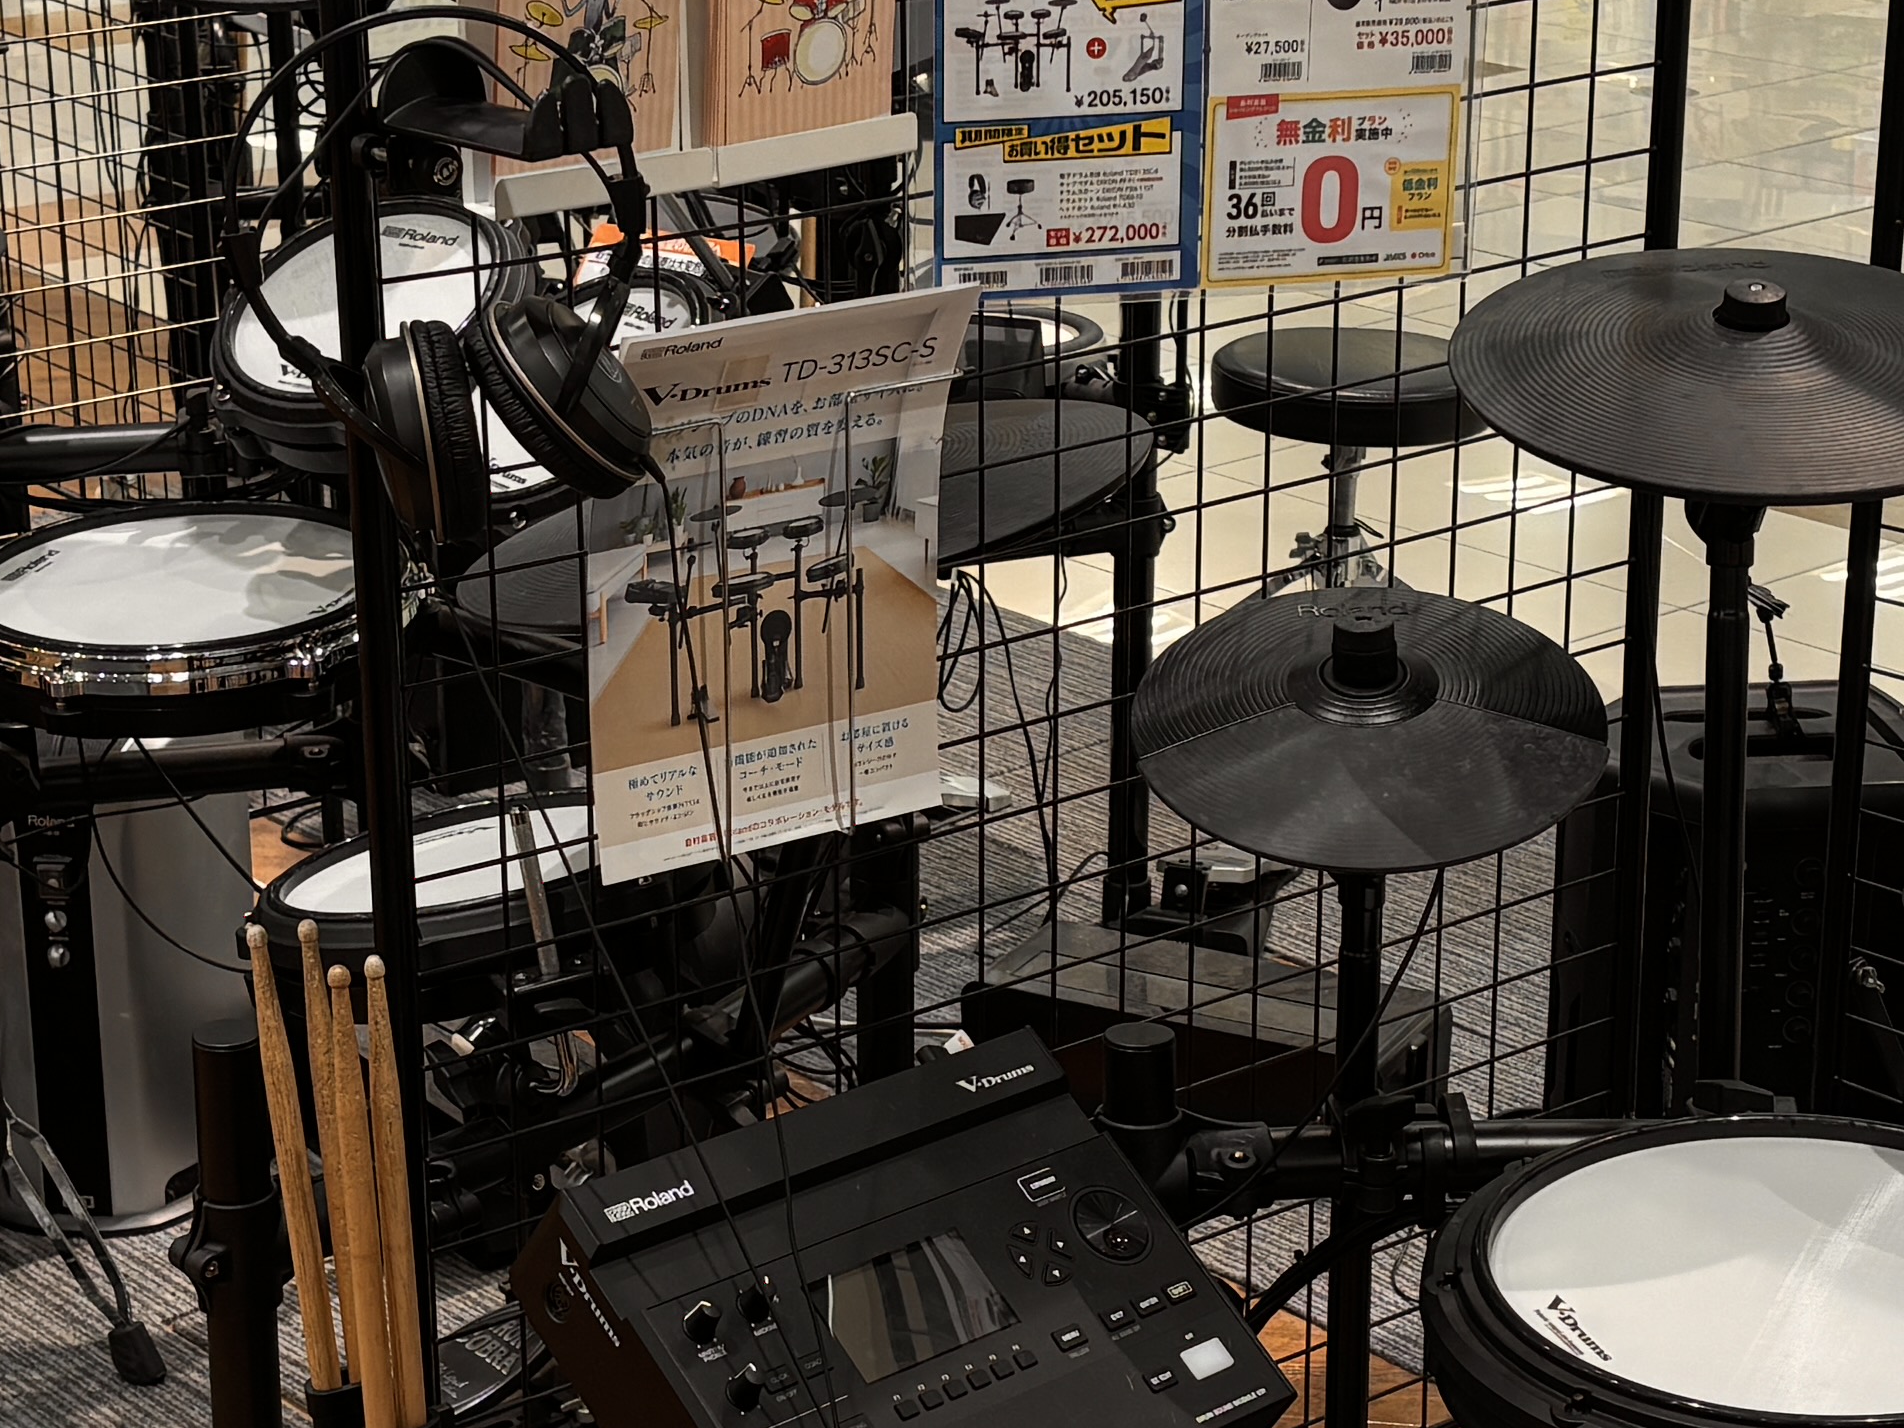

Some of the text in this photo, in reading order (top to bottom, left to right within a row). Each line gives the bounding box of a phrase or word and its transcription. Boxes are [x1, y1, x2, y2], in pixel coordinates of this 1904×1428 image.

[1244, 39, 1300, 57] ¥27,500
[1378, 27, 1447, 50] ¥35,000
[1073, 87, 1165, 109] ¥205,150
[1006, 123, 1167, 159] お買い得セット
[1275, 115, 1389, 147] 無金利 プラン
[1354, 126, 1394, 142] 実施中
[1225, 191, 1277, 221] 36 回
[1300, 154, 1384, 245] 0 円
[1072, 222, 1161, 245] ¥272,000
[662, 336, 724, 358] Roland
[781, 335, 939, 384] TD-313SC-S
[628, 1179, 696, 1215] Roland
